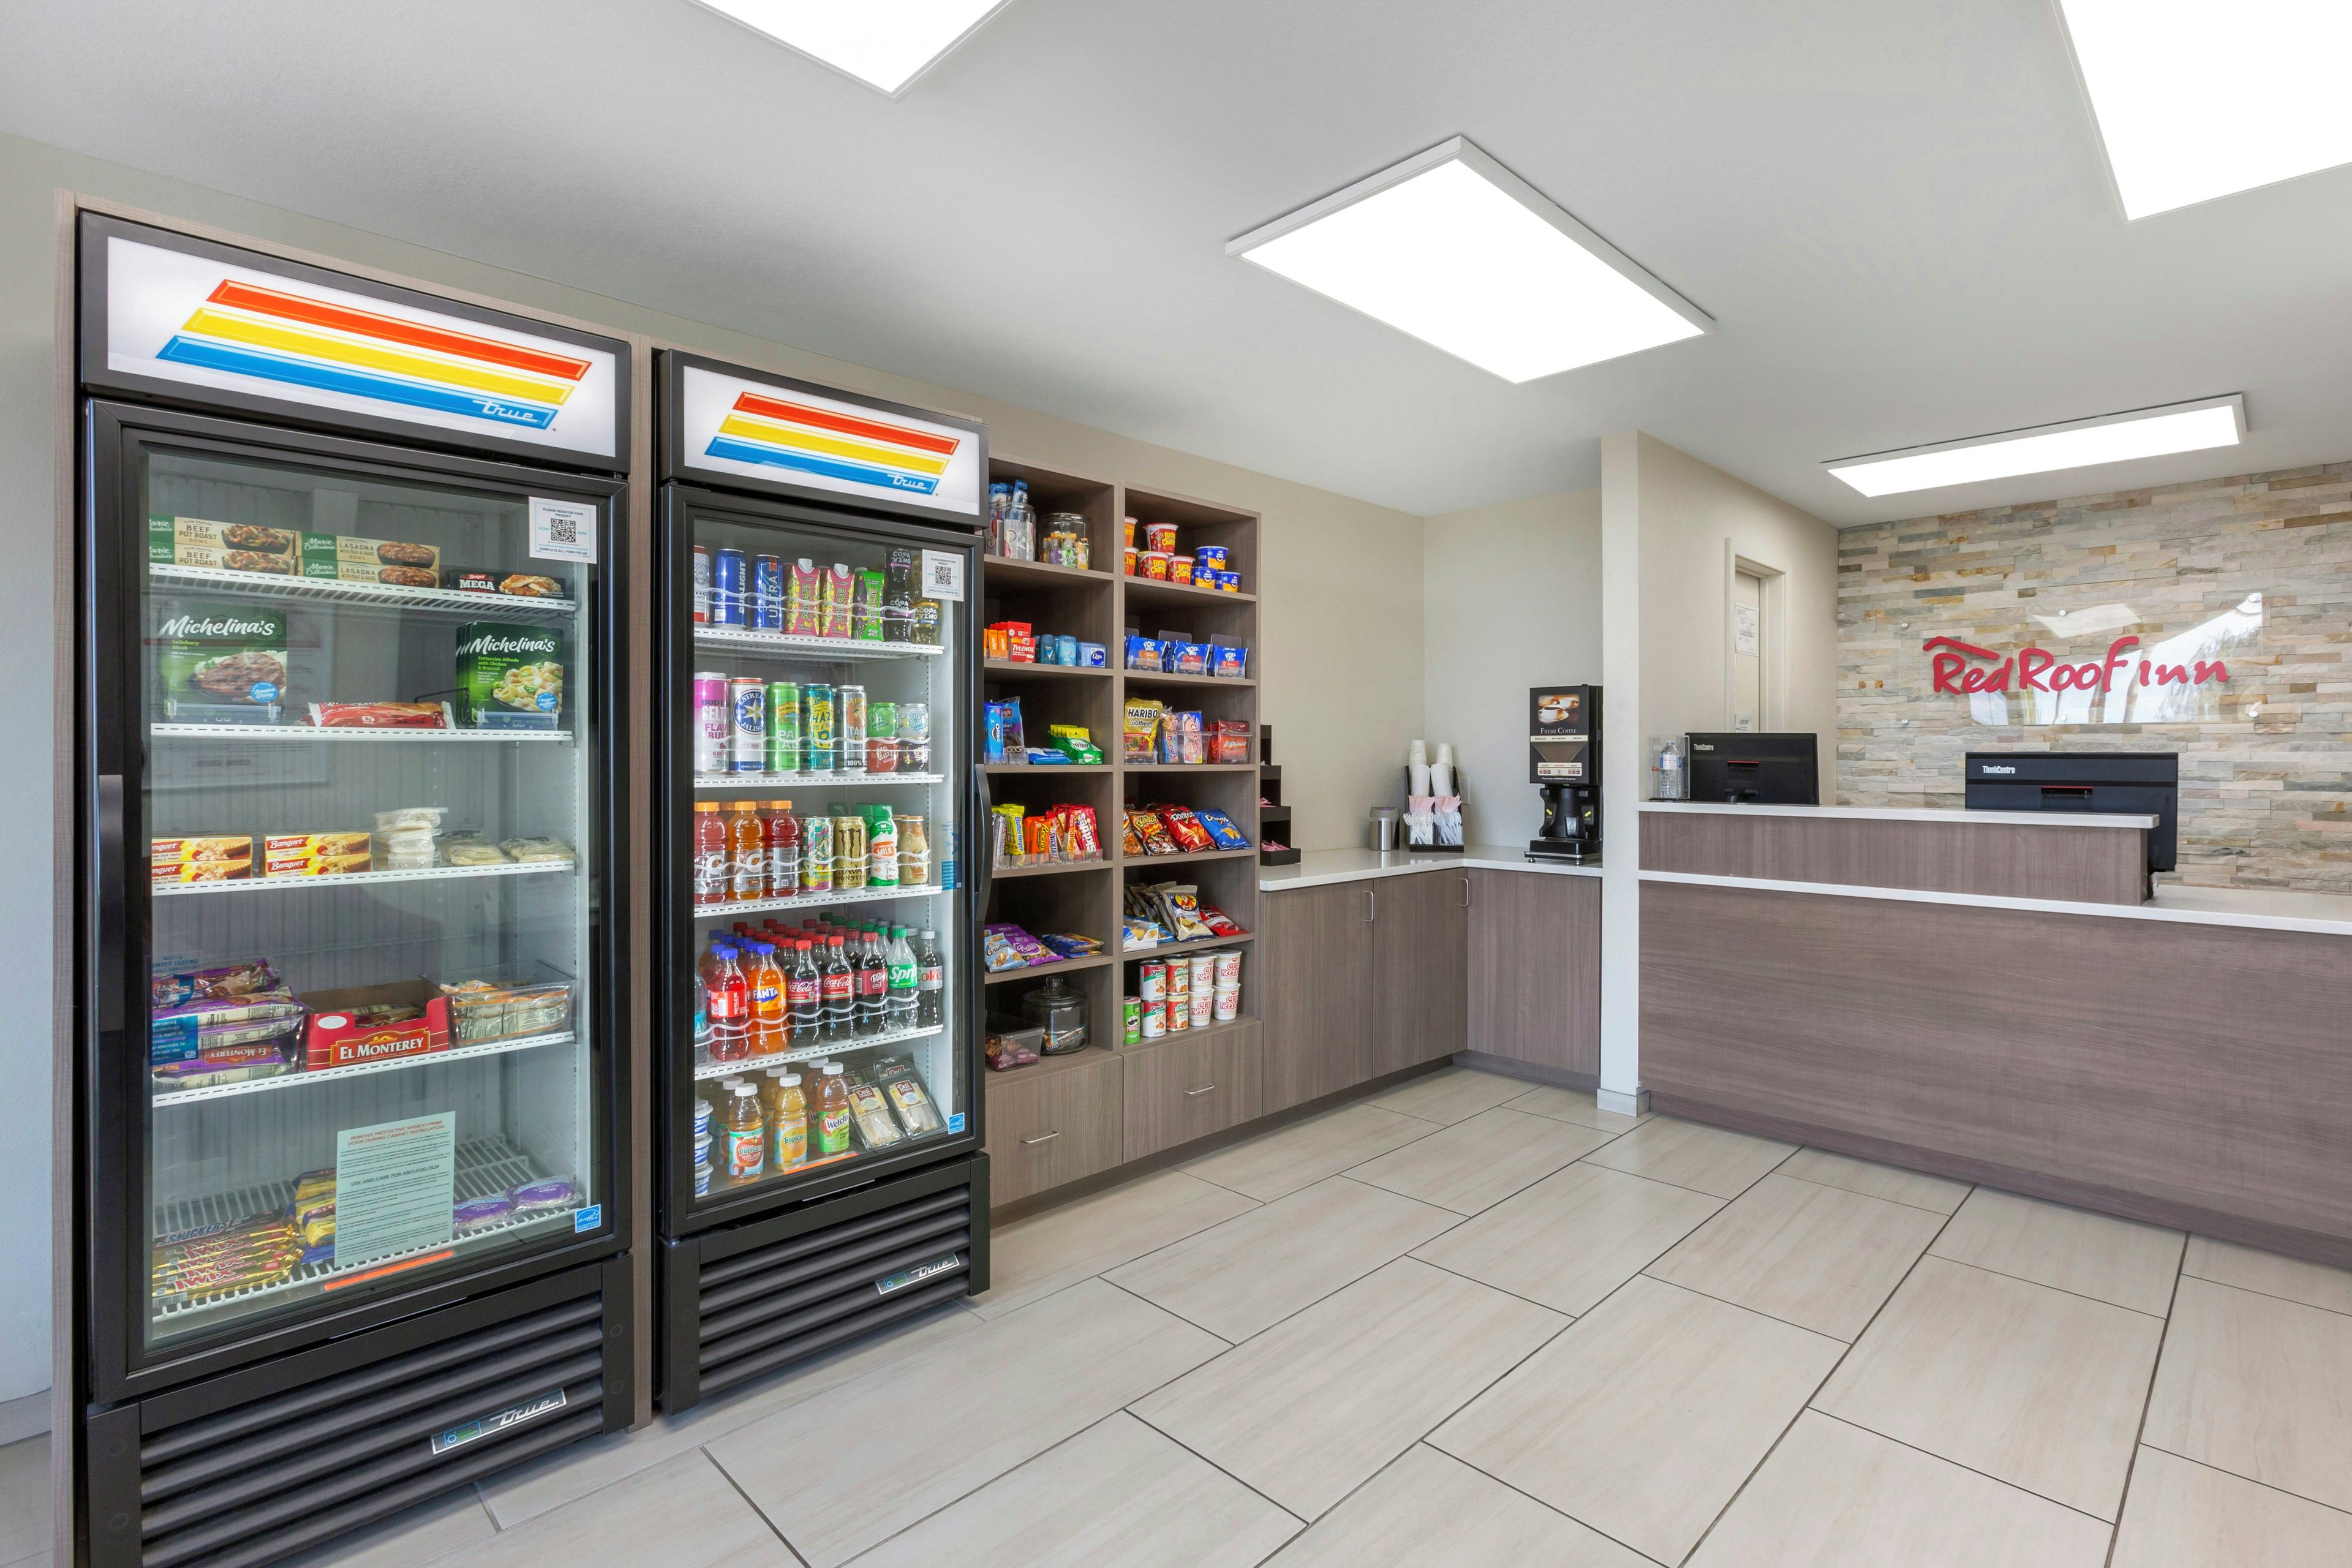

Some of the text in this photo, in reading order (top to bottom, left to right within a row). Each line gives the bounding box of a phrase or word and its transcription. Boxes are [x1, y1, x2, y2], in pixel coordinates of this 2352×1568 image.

[339, 543, 374, 551] LASAGNA
[459, 579, 495, 590] MEGA
[158, 615, 275, 638] Michelina's
[470, 635, 555, 655] Michelina's
[1933, 652, 2013, 695] Red
[2018, 636, 2139, 693] Roof
[1128, 708, 1158, 718] HARIBO
[1983, 766, 2015, 774] ThinkCentre
[1171, 812, 1194, 821] Doritos
[1014, 816, 1023, 851] Butterfinger
[1078, 813, 1096, 853] Skittles
[270, 839, 304, 849] Banquet
[877, 847, 892, 856] MILK
[271, 861, 306, 870] Banquet
[753, 987, 778, 999] FANTA
[210, 1048, 255, 1058] MONTEREY
[340, 1038, 424, 1060] EL MONTEREY
[827, 1112, 848, 1129] Welch's
[374, 1127, 405, 1136] PROTECTIVE
[410, 1125, 445, 1134] INSTALLATION
[402, 1167, 427, 1176] ANTI-FOG
[167, 1222, 227, 1243] SNICKERS
[174, 1270, 236, 1292] TWIX
